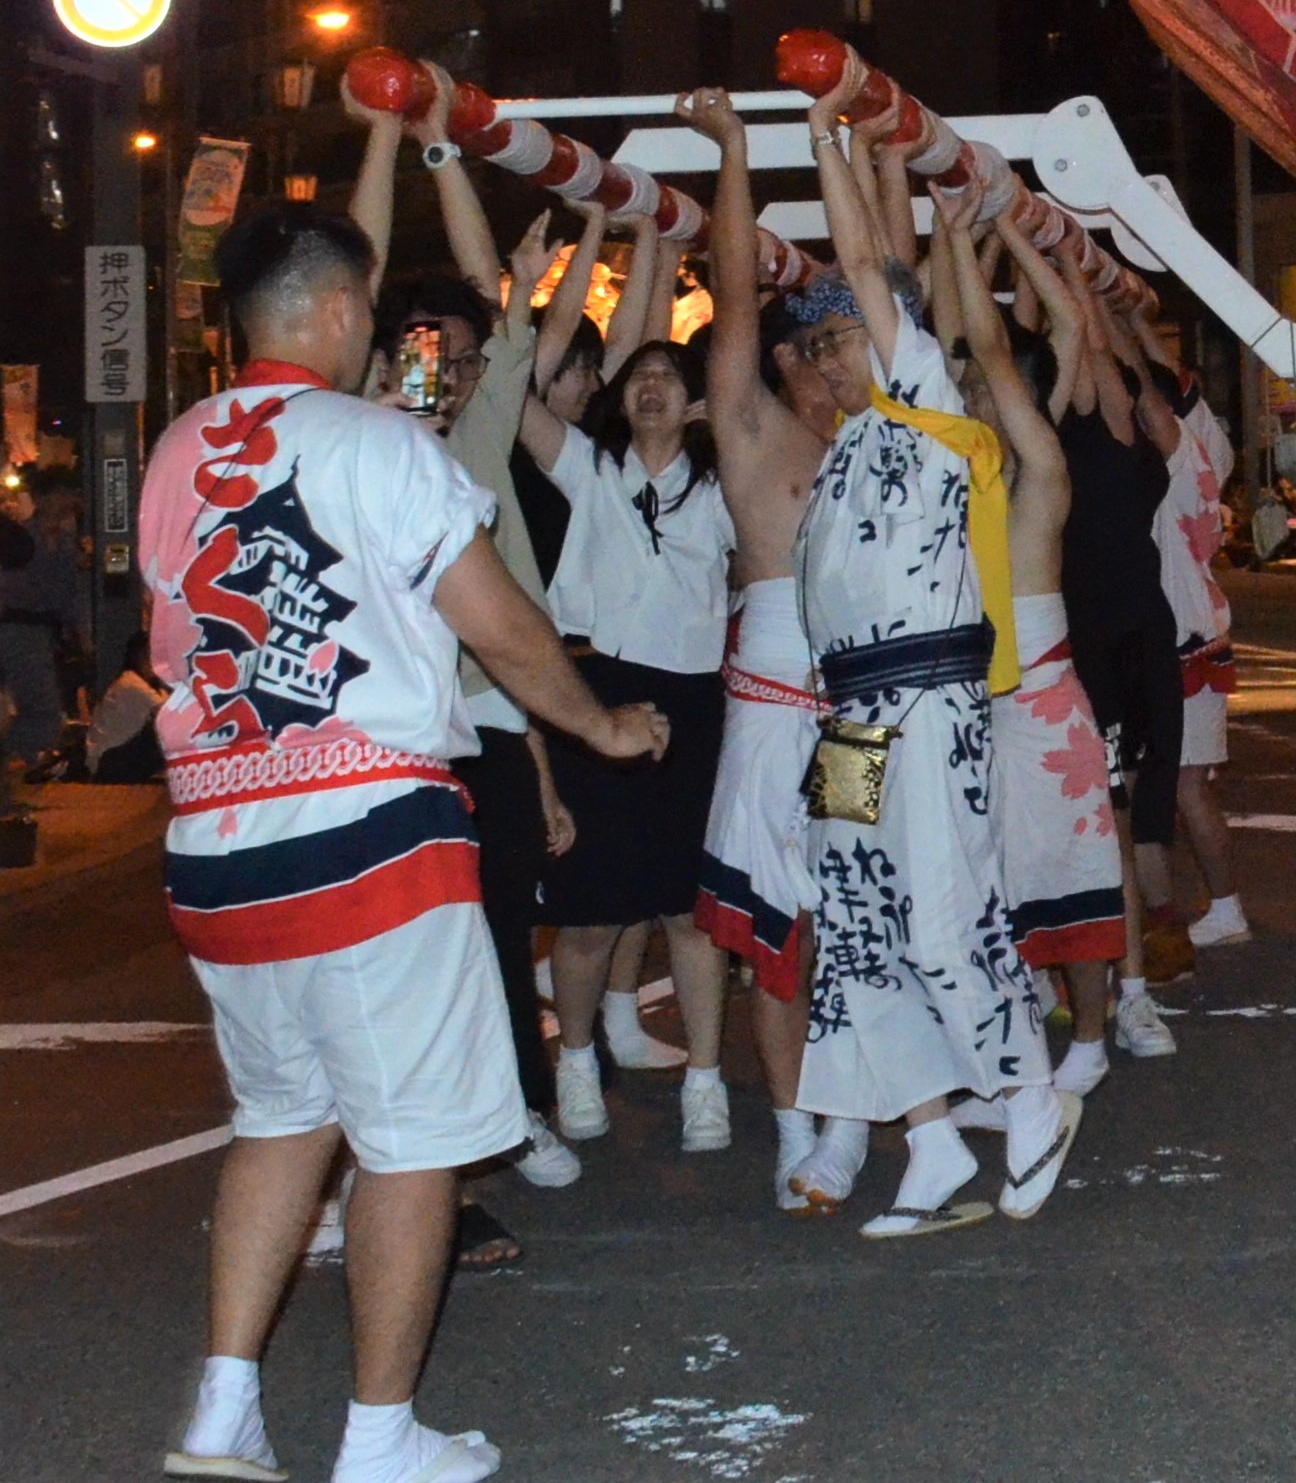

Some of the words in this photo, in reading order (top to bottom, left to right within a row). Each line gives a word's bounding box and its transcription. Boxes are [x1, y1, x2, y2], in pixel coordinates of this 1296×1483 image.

[99, 251, 130, 397] 押ボタン信号
